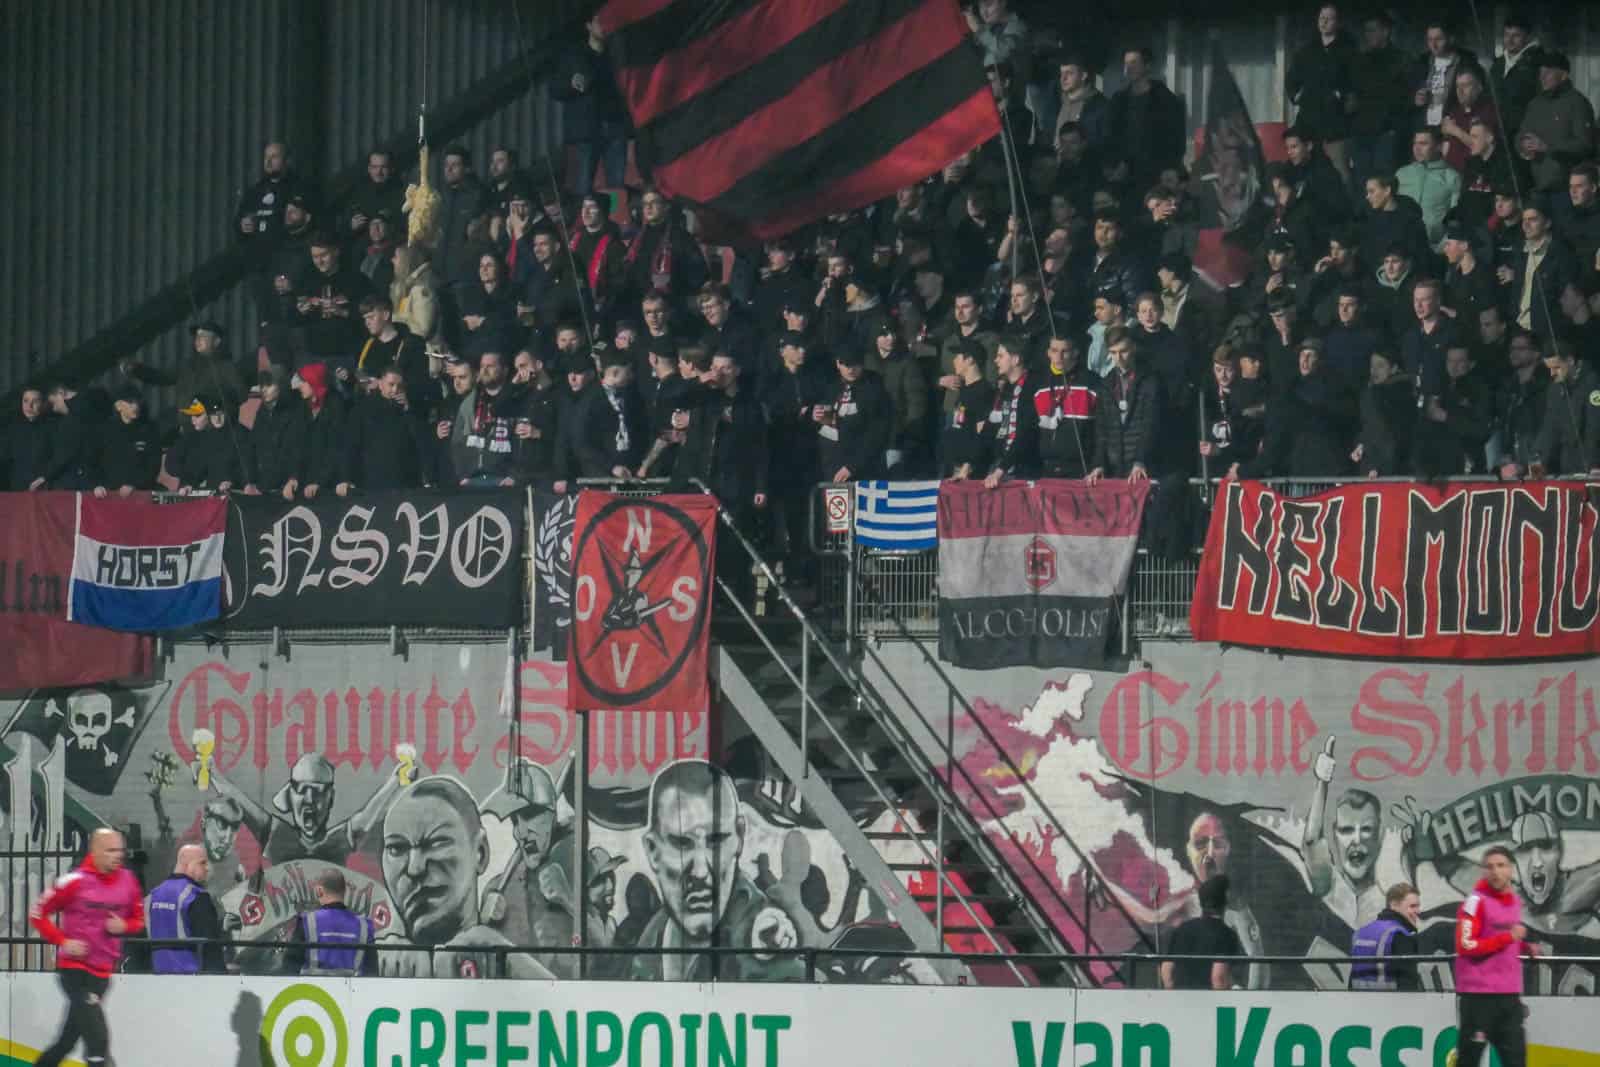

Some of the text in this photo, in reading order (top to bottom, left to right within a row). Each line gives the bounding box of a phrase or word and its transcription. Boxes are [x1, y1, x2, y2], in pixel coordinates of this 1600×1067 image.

[96, 543, 202, 588] HORST
[363, 1007, 793, 1067] GREENPOINT
[1011, 1019, 1171, 1067] van
